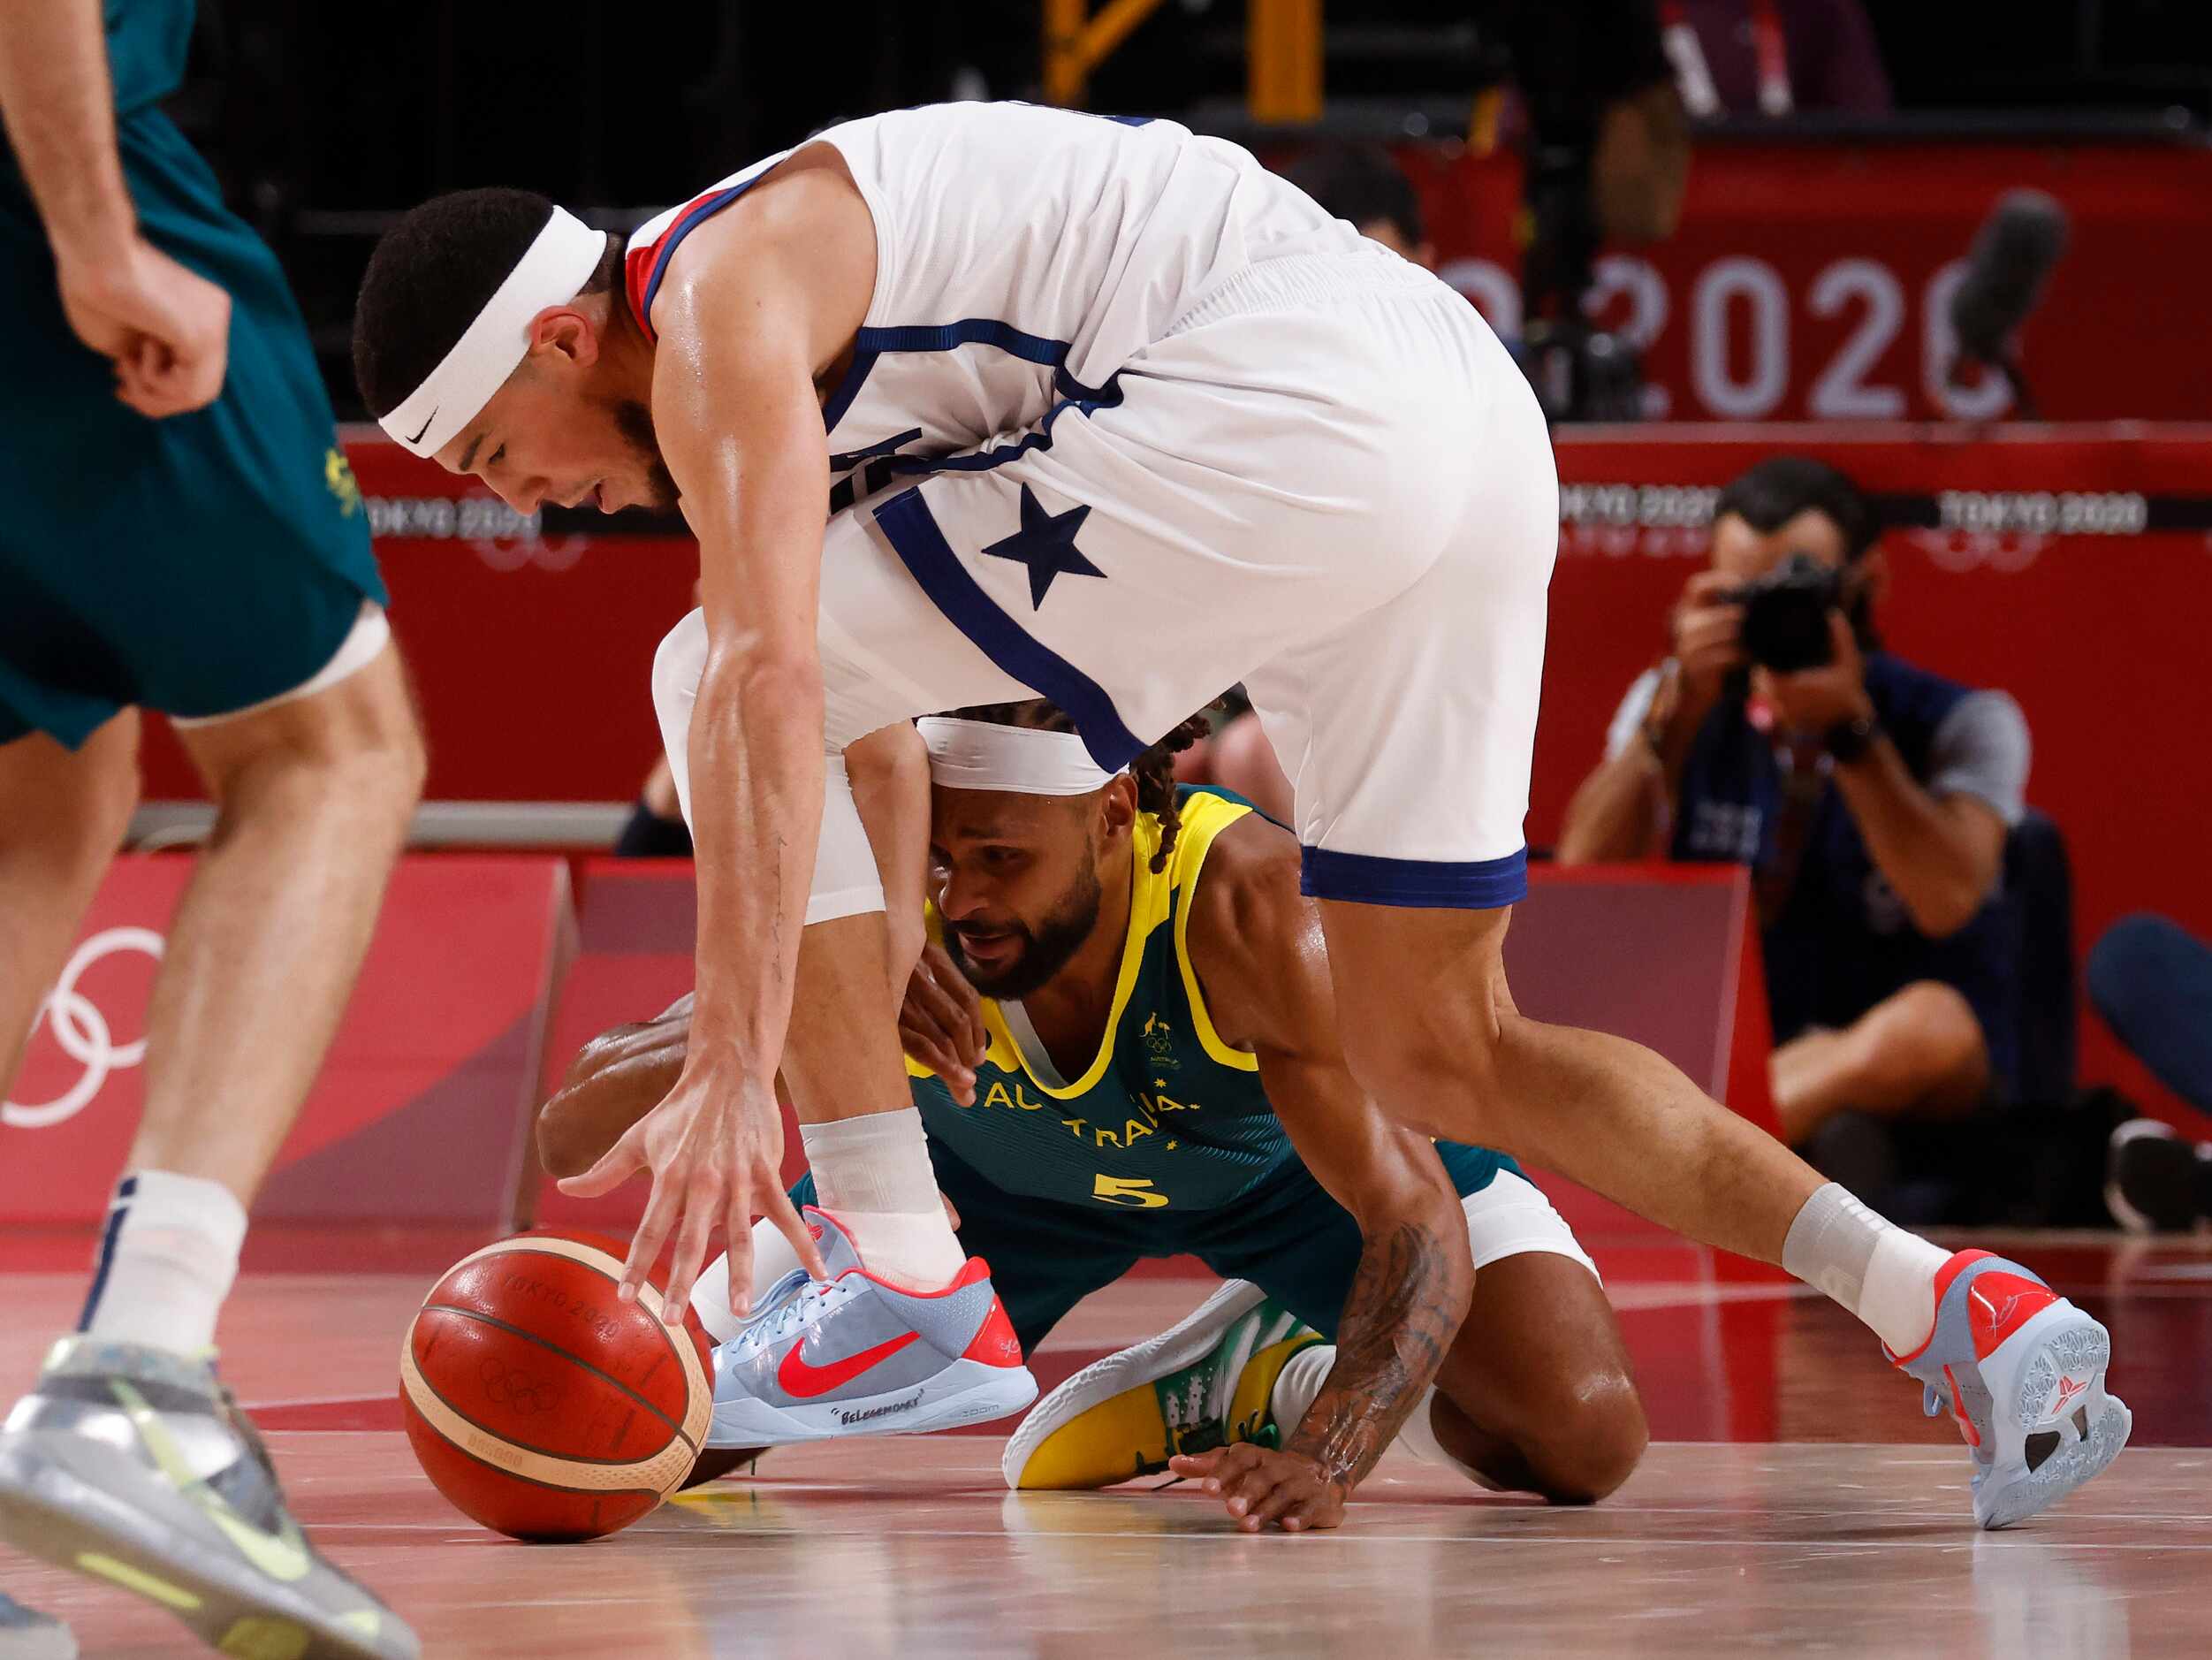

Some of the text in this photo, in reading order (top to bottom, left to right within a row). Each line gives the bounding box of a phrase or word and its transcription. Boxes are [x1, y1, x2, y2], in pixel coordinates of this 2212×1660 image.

[1939, 491, 2147, 536] TOKYO 2020
[1091, 1173, 1169, 1208] 5
[503, 1272, 567, 1308] TOKYO
